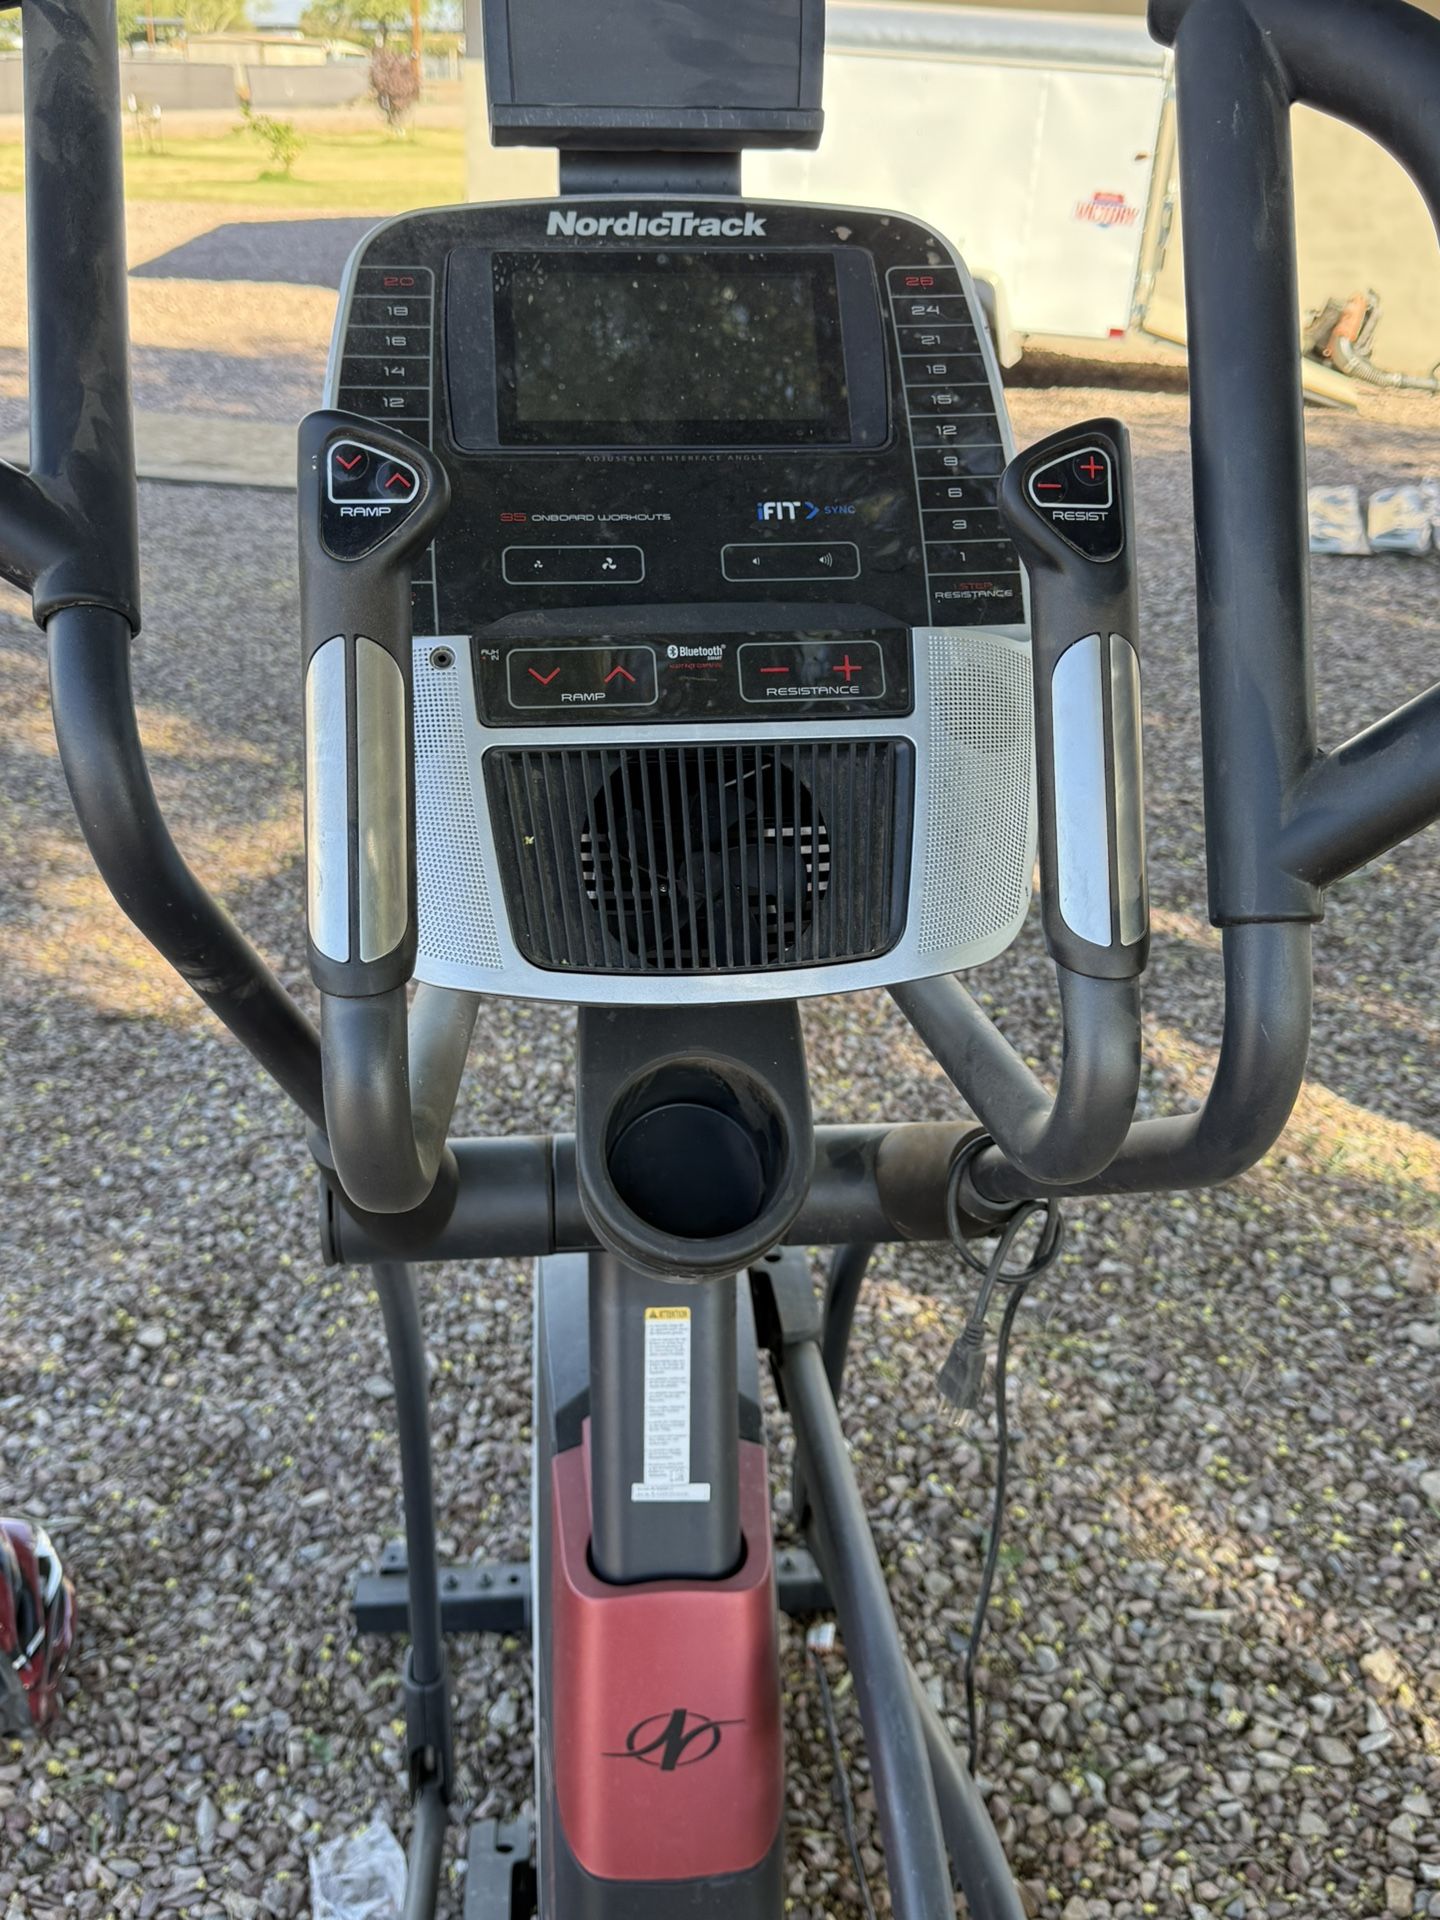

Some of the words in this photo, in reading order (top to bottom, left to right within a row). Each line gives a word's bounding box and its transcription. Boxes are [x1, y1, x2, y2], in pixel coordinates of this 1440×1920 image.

[546, 210, 767, 238] NordicTrack
[383, 276, 415, 288] 20
[387, 306, 409, 317] 18
[911, 305, 940, 316] 24
[385, 336, 407, 347] 16
[921, 335, 941, 345] 21
[384, 366, 405, 377] 14
[926, 364, 947, 375] 18
[383, 397, 405, 408] 12
[931, 394, 952, 405] 15
[936, 425, 957, 436] 12
[661, 454, 721, 462] INTERFACE
[944, 456, 959, 467] 9
[948, 487, 962, 498] 6
[340, 506, 391, 517] RAMP
[757, 501, 800, 521] iFIT
[824, 505, 856, 514] SYNC
[1052, 511, 1108, 521] RESIST
[531, 513, 595, 522] ONBOARD
[597, 513, 671, 521] WORKOUTS
[952, 519, 967, 530] 3
[960, 551, 966, 562] 1
[934, 590, 1013, 599] RESISTANCE
[561, 692, 606, 701] RAMP
[766, 686, 860, 696] RESISTANCE
